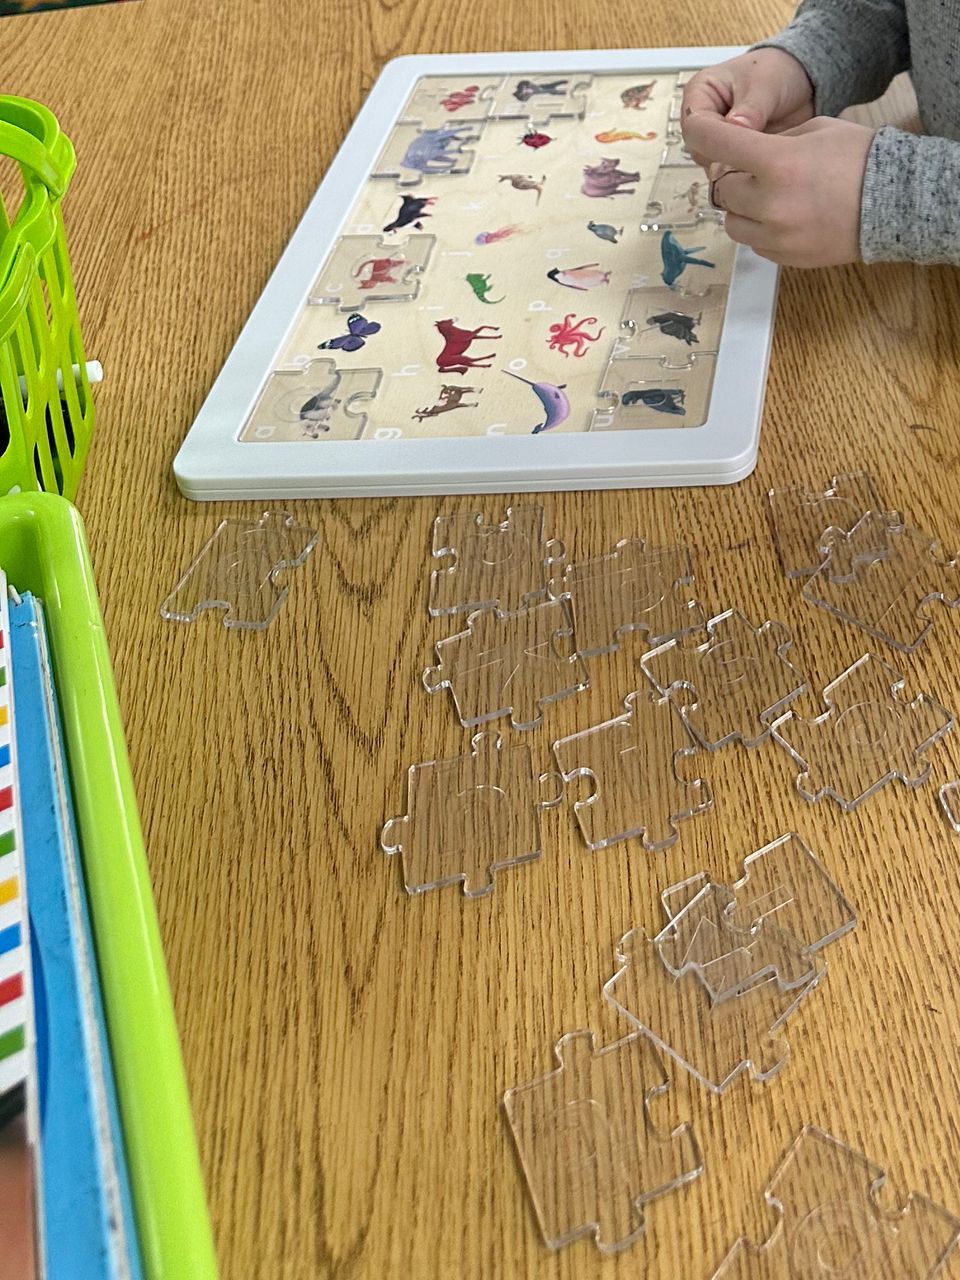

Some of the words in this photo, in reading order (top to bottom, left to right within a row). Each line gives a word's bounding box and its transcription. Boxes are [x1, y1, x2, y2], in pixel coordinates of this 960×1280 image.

[545, 248, 571, 259] q
[528, 300, 552, 311] p
[509, 358, 527, 370] o
[392, 365, 420, 376] h
[255, 426, 276, 439] a
[374, 428, 402, 439] g
[486, 424, 508, 436] n
